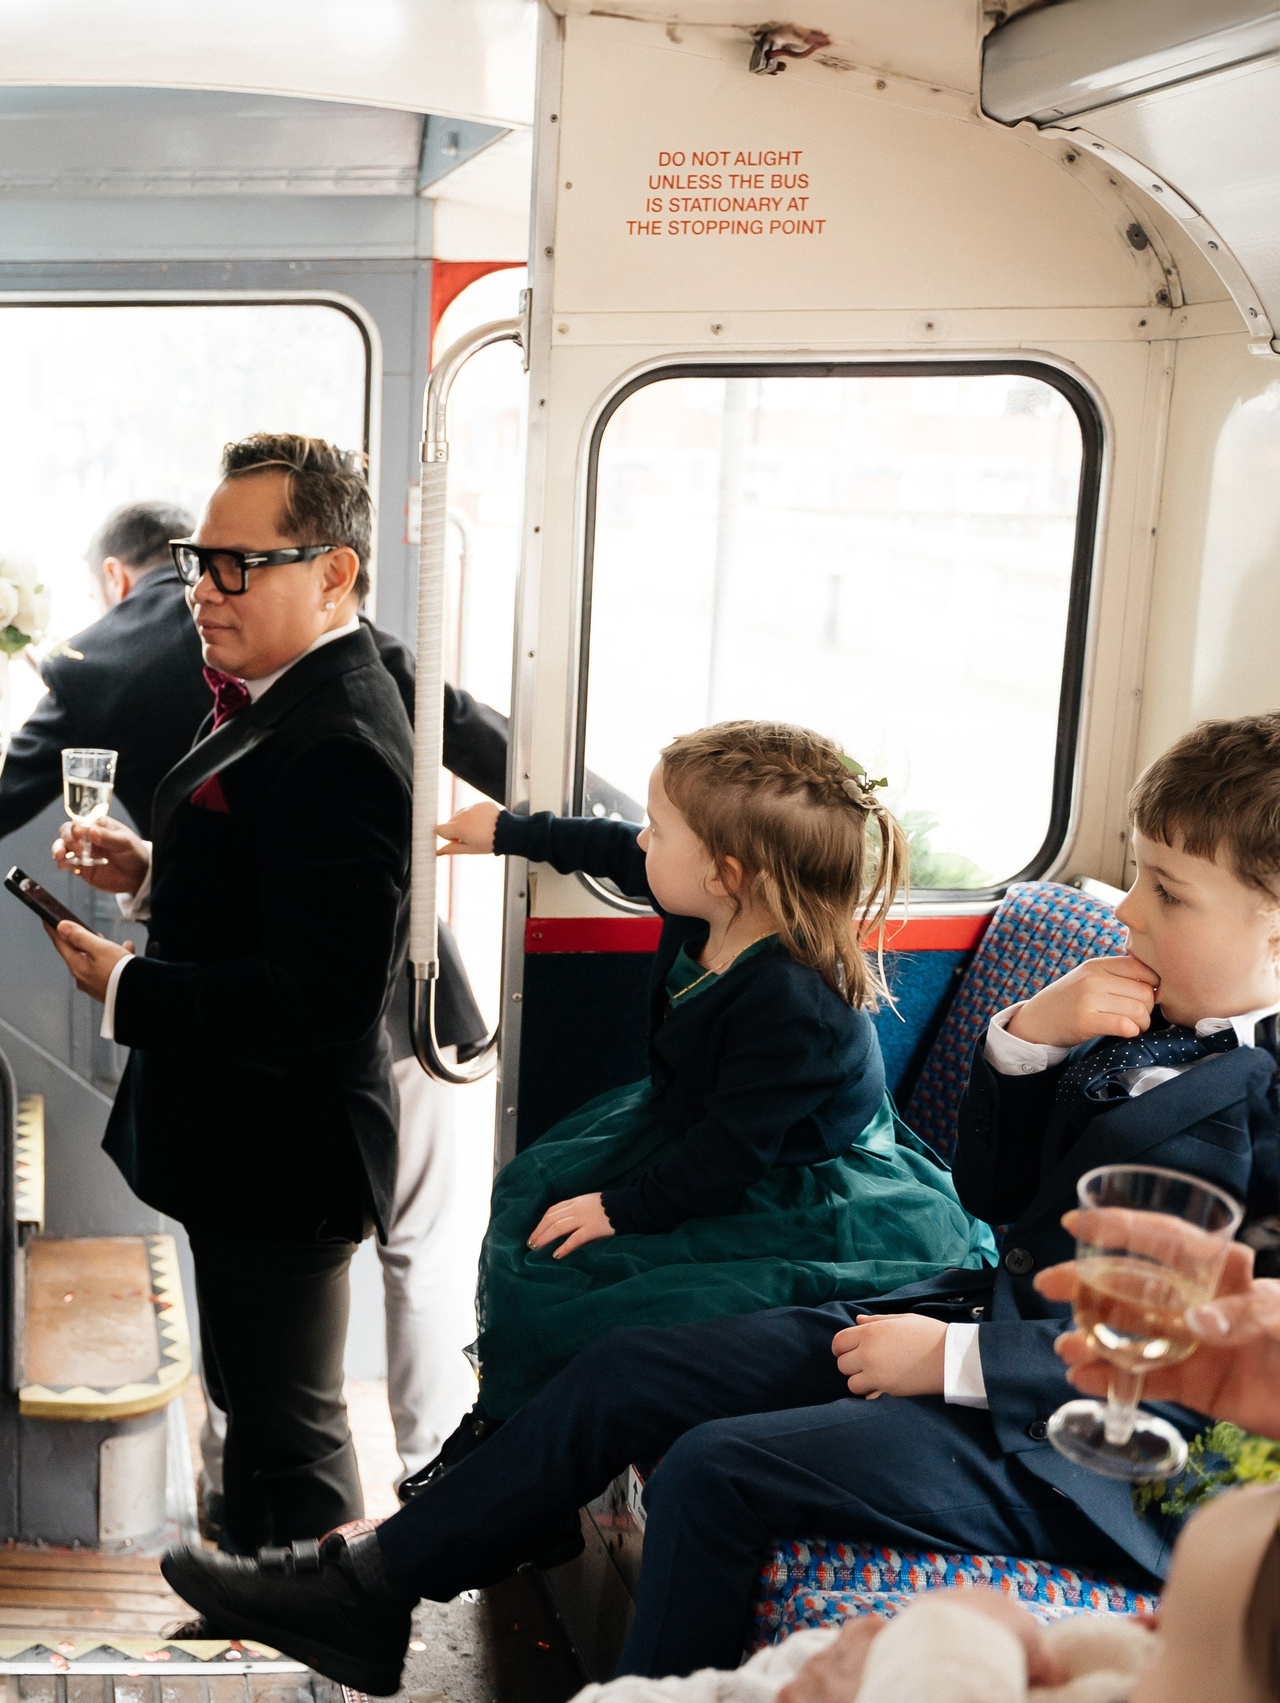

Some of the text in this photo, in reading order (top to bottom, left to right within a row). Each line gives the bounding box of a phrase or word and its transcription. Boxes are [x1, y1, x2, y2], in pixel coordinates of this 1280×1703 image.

[658, 150, 803, 167] DO NOT ALIGHT
[648, 173, 810, 190] UNLESS THE BUS
[646, 196, 810, 213] IS STATIONARY AT
[626, 219, 827, 236] THE STOPPING POINT
